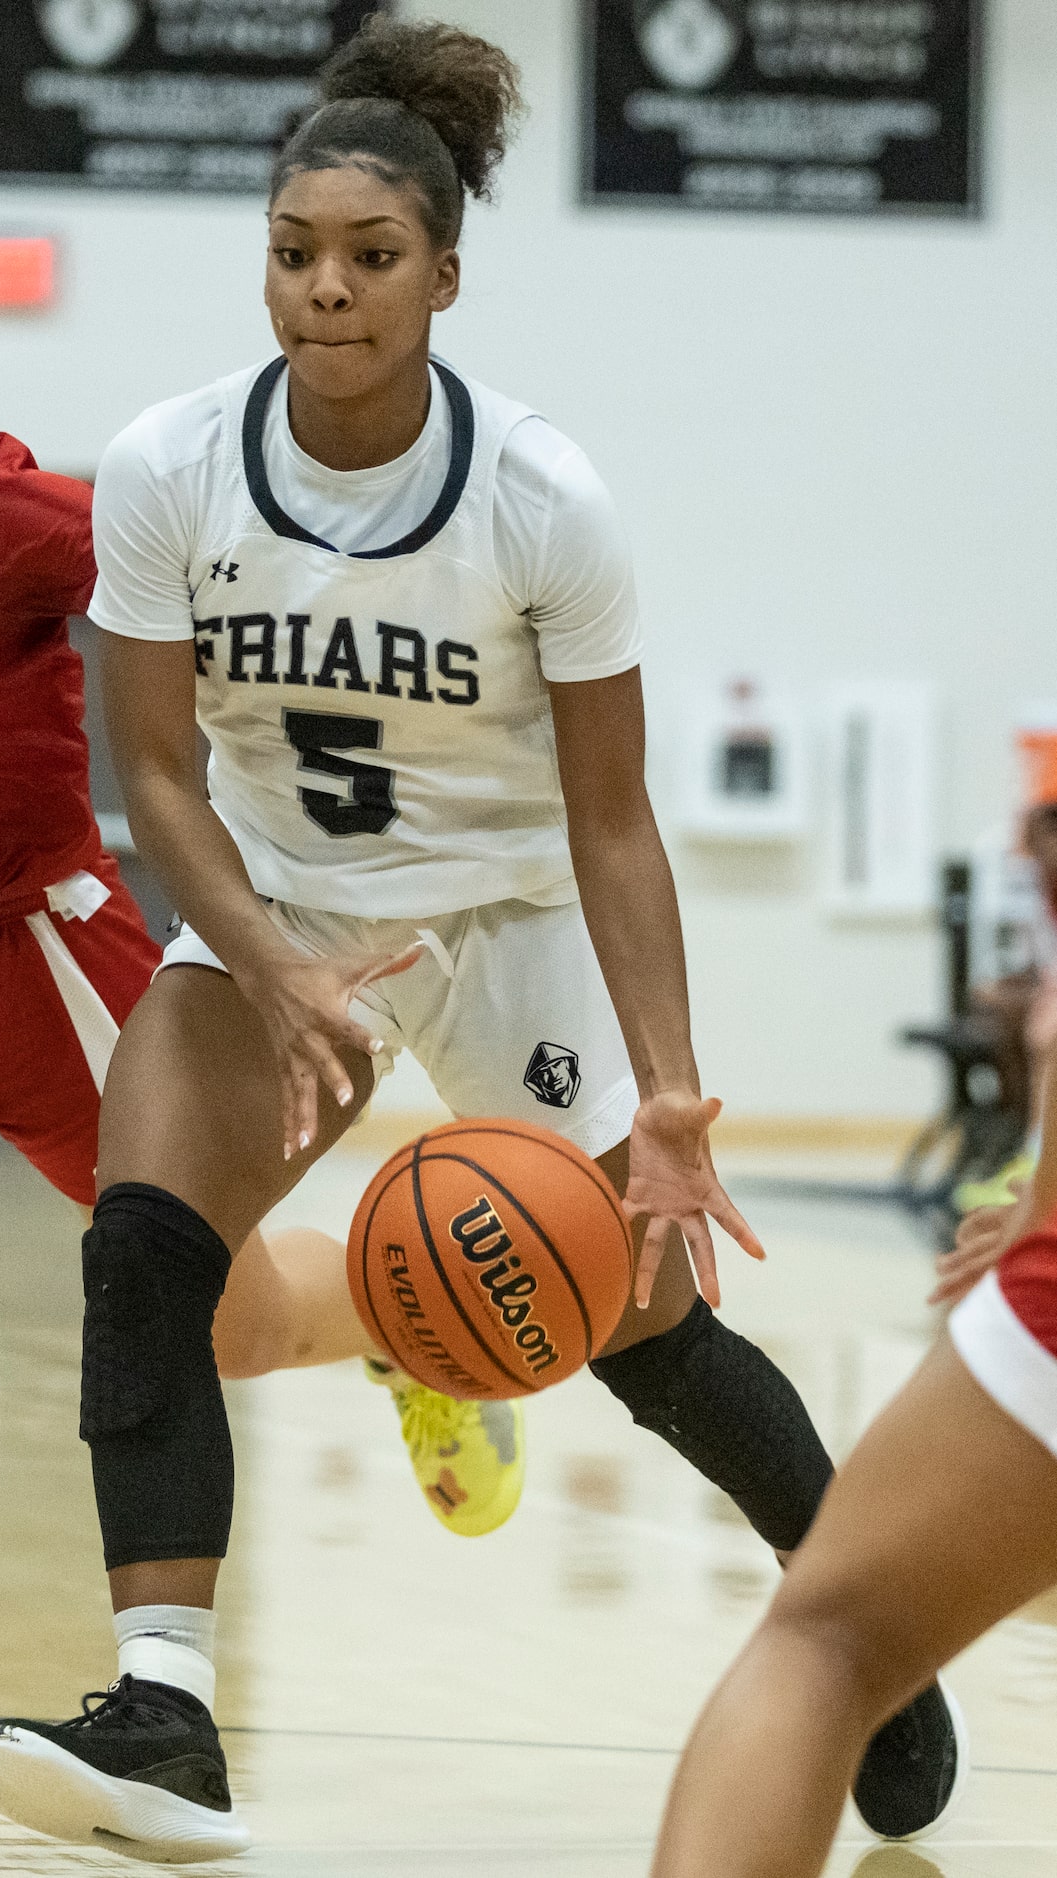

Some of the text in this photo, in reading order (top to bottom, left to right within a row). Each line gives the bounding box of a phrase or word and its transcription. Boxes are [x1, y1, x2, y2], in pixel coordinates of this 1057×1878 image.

[194, 611, 480, 706] FRIARS
[281, 706, 401, 839] 5
[448, 1193, 563, 1376] Wilson
